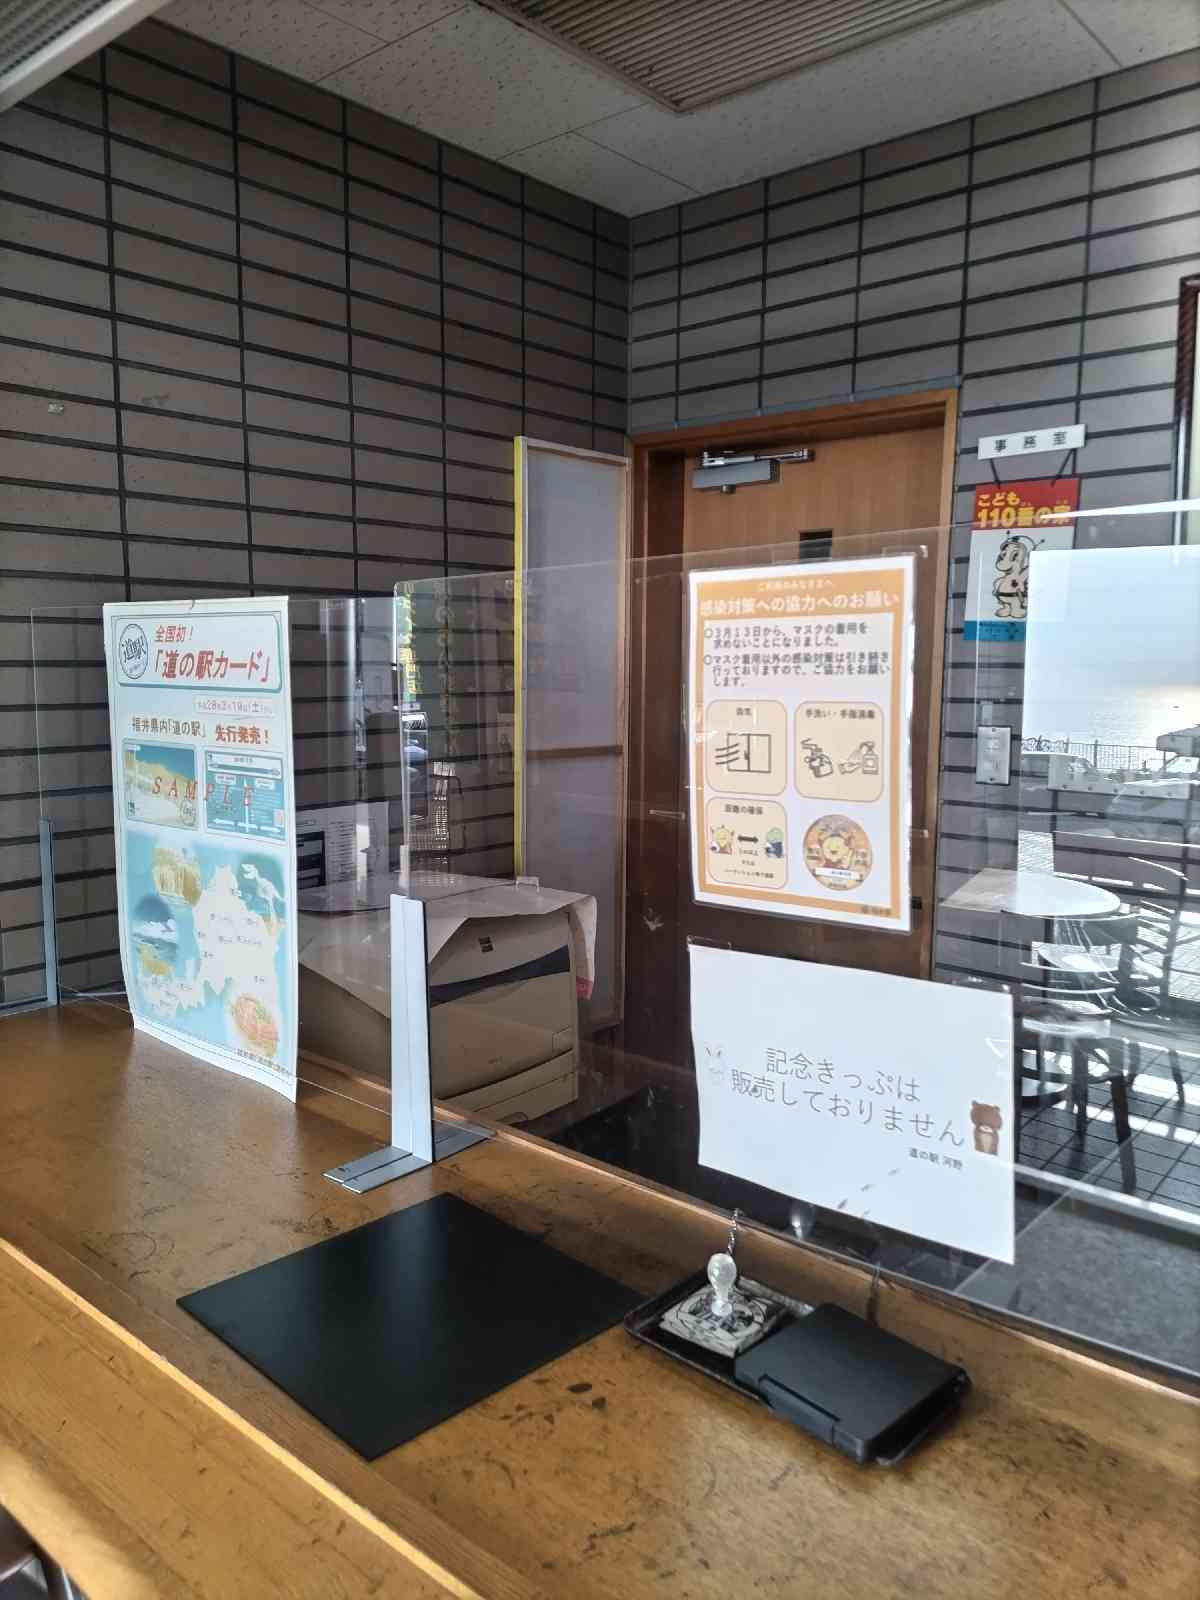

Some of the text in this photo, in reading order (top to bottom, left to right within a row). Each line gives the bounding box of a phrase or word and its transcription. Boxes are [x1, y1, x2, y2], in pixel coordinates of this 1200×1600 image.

[994, 431, 1067, 454] 事務室
[977, 491, 1020, 507] こども
[977, 505, 1072, 529] 110番の家
[700, 590, 900, 617] 感染対策への協力へのお願い
[154, 649, 271, 683] 「道の駅カード」
[712, 663, 890, 677] 行っておりますので、ご協力をお願い
[132, 717, 208, 738] 福井県内「道の駅」
[765, 1047, 922, 1104] 記念きっぷは
[731, 1068, 965, 1147] 販売しておりません
[942, 1156, 964, 1172] 河野
